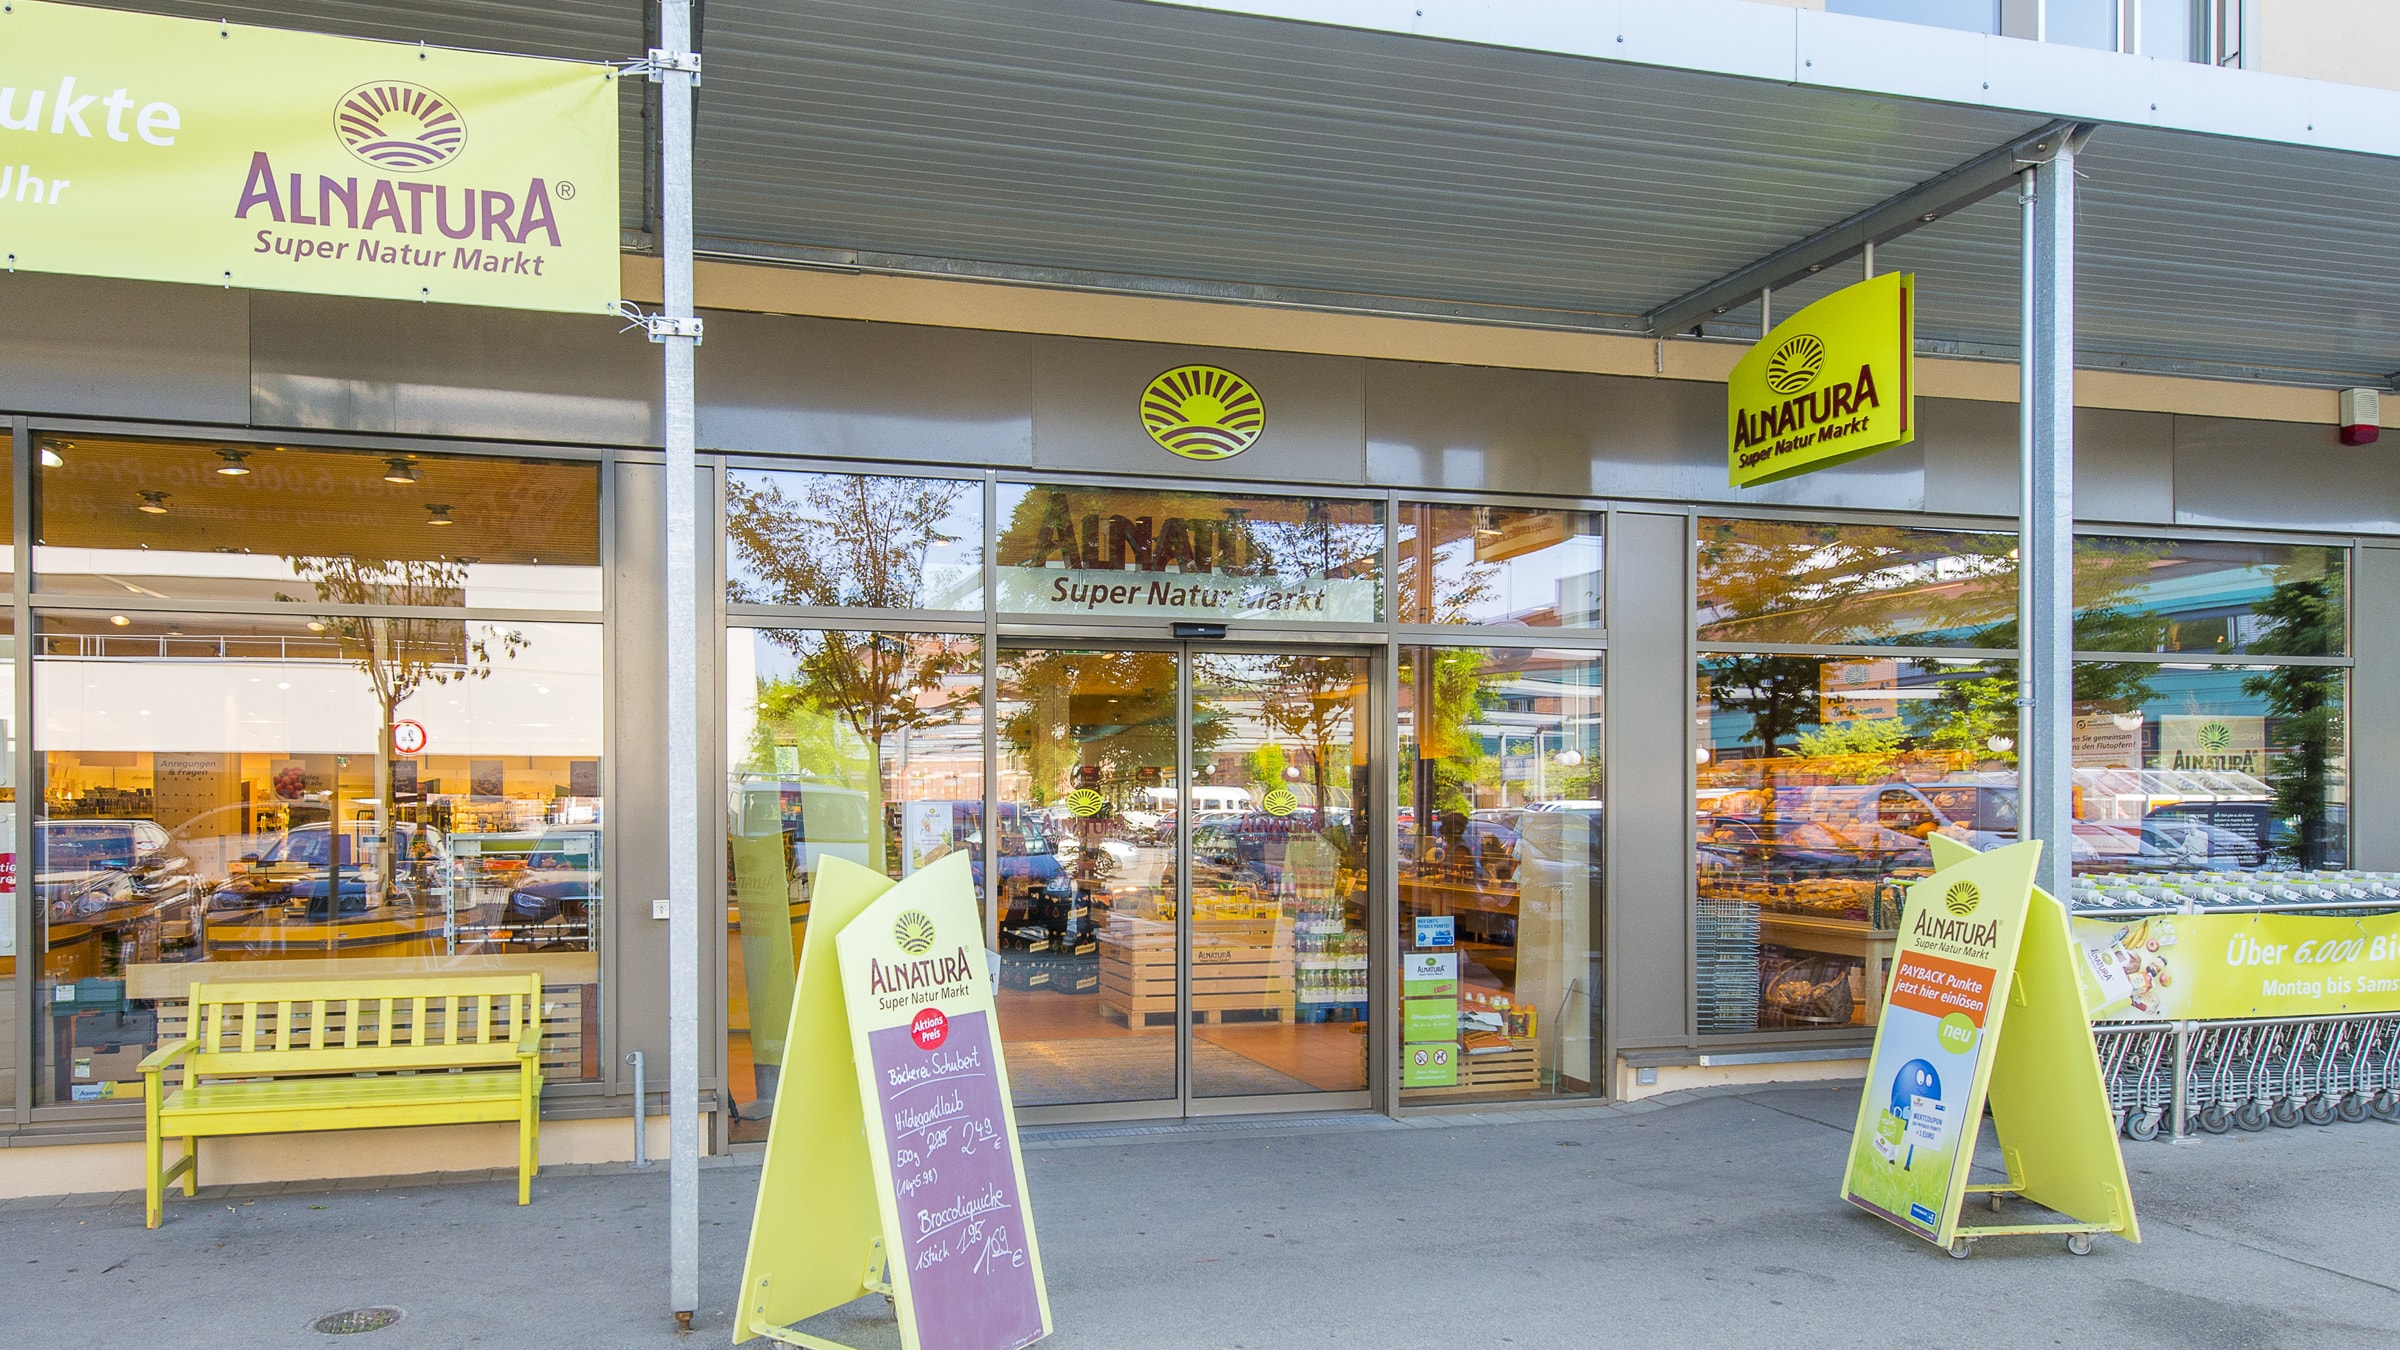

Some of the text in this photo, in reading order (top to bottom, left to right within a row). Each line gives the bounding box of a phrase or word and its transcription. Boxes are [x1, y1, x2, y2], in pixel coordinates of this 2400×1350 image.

[254, 229, 544, 276] Super Natur Markt
[1733, 364, 1880, 453] ALNATURA
[1739, 416, 1869, 469] Super Natur Markt
[1051, 576, 1142, 609] Super
[1148, 581, 1233, 608] Natur
[2081, 742, 2095, 750] den
[2096, 742, 2136, 751] Flutopfern!
[2082, 734, 2093, 742] Sie
[2093, 734, 2133, 743] gemeinsam
[160, 760, 216, 769] Anregungen
[1913, 908, 1998, 949] ALNATURA
[1915, 937, 1990, 960] Super Natur Markt
[2227, 933, 2288, 966] Über
[2293, 938, 2365, 965] 6.000
[871, 946, 973, 996] ALNATURA
[1900, 963, 1983, 994] PAYBACK Punkte
[879, 985, 970, 1011] Super Natur Markt
[1894, 978, 1984, 1012] jetzt hier einlösen
[2262, 976, 2399, 999] Montag bis Sams
[913, 1015, 943, 1034] Aktions
[922, 1029, 941, 1043] Preis
[1942, 1023, 1972, 1044] neu
[932, 1045, 980, 1075] Schubert
[897, 1149, 921, 1168] 500g
